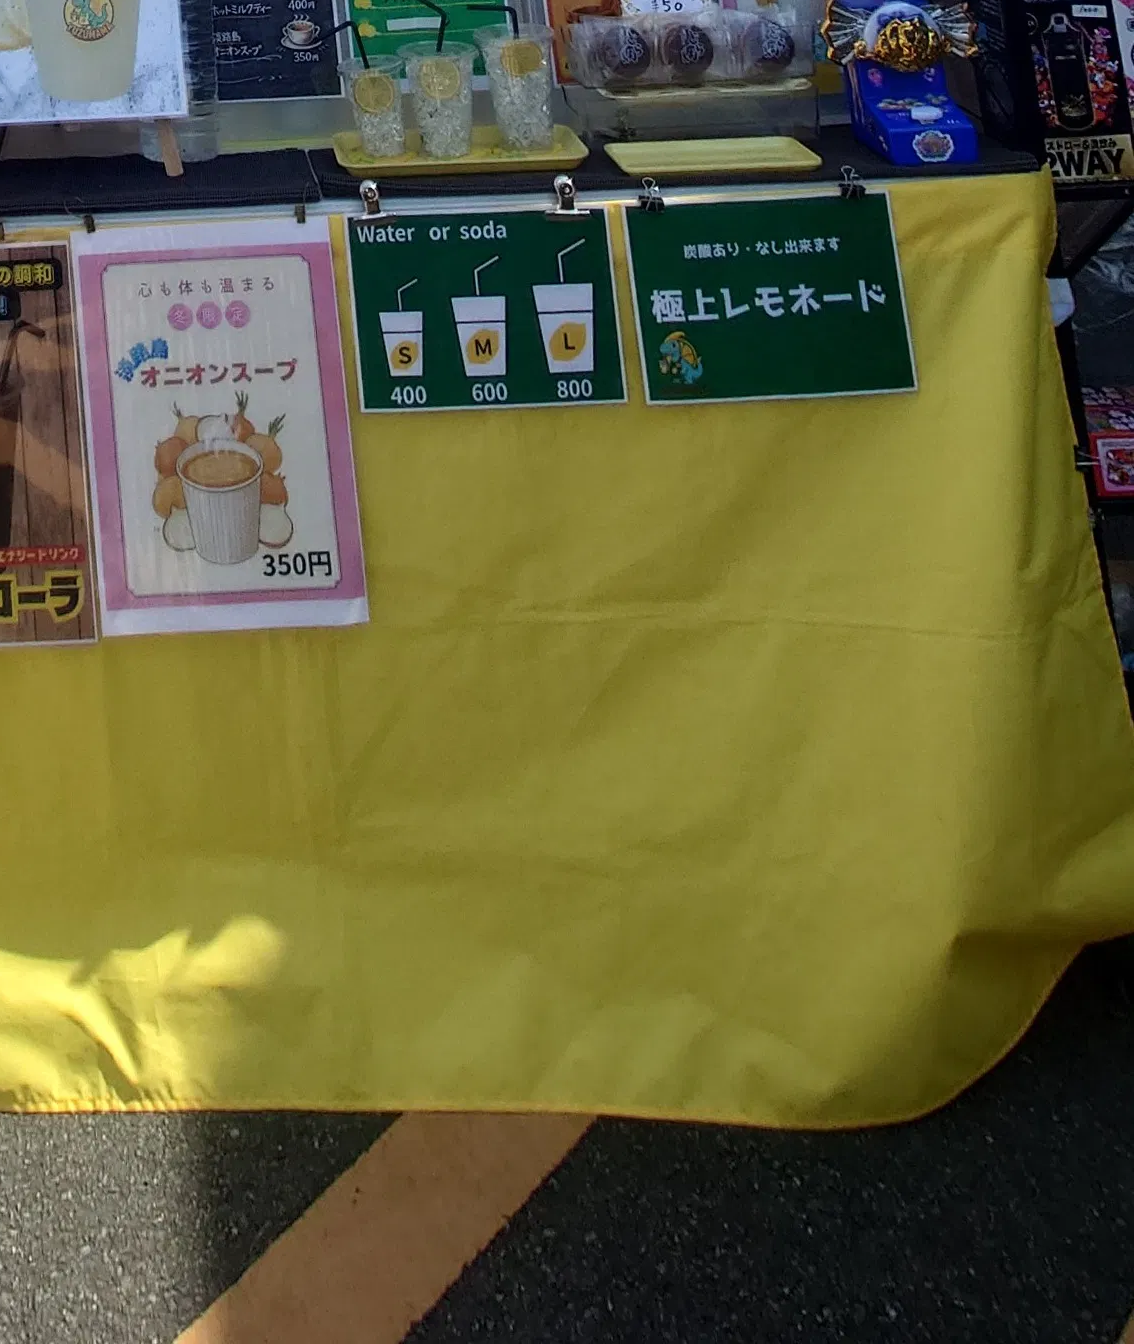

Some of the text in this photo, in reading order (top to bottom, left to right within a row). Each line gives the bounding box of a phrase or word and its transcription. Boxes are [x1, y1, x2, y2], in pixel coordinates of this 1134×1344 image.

[356, 221, 508, 244] Water or soda
[682, 236, 841, 261] 炭酸あり・なし出来ます
[137, 276, 276, 299] 心も体も温まる
[651, 279, 887, 324] 極上レモネード
[474, 338, 493, 357] M
[563, 332, 576, 351] L
[397, 345, 412, 364] S
[140, 357, 298, 388] オニオンスープ
[390, 378, 594, 406] 400 600 800
[263, 550, 334, 578] 350円
